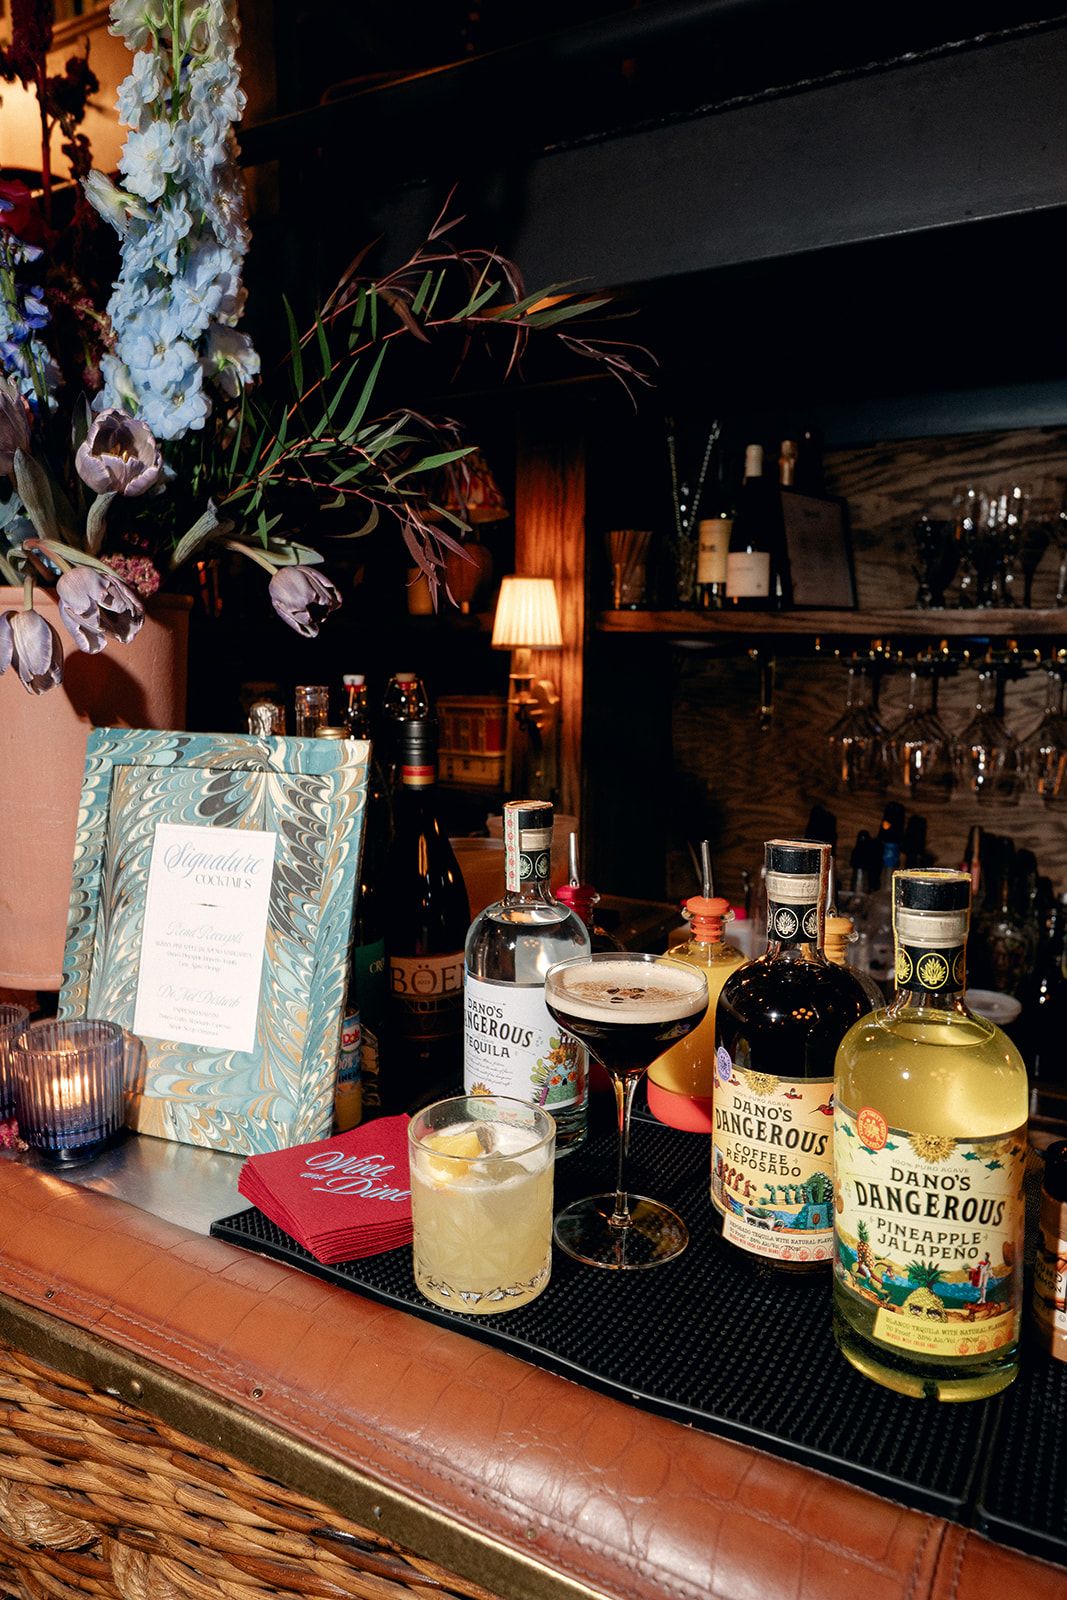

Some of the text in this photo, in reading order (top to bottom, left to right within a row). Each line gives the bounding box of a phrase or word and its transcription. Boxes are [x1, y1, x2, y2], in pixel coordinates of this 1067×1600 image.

[163, 841, 264, 879] Signature
[195, 874, 252, 889] COCKTAILS
[468, 997, 504, 1020] DANO'S
[464, 1011, 534, 1048] NGEROUS
[465, 1033, 511, 1059] TEQUILA
[733, 1096, 793, 1122] DANO'S
[715, 1108, 829, 1156] DANGEROUS
[305, 1151, 396, 1178] Wine
[726, 1147, 801, 1177] REPOSADO
[734, 1142, 788, 1166] COFFEE
[311, 1176, 412, 1202] Dine
[889, 1166, 971, 1192] DANO'S
[854, 1180, 1006, 1227] DANGEROUS
[877, 1217, 982, 1245] PINEAPPLE
[878, 1233, 979, 1260] JALAPEÑO
[959, 1326, 987, 1336] NATURAL
